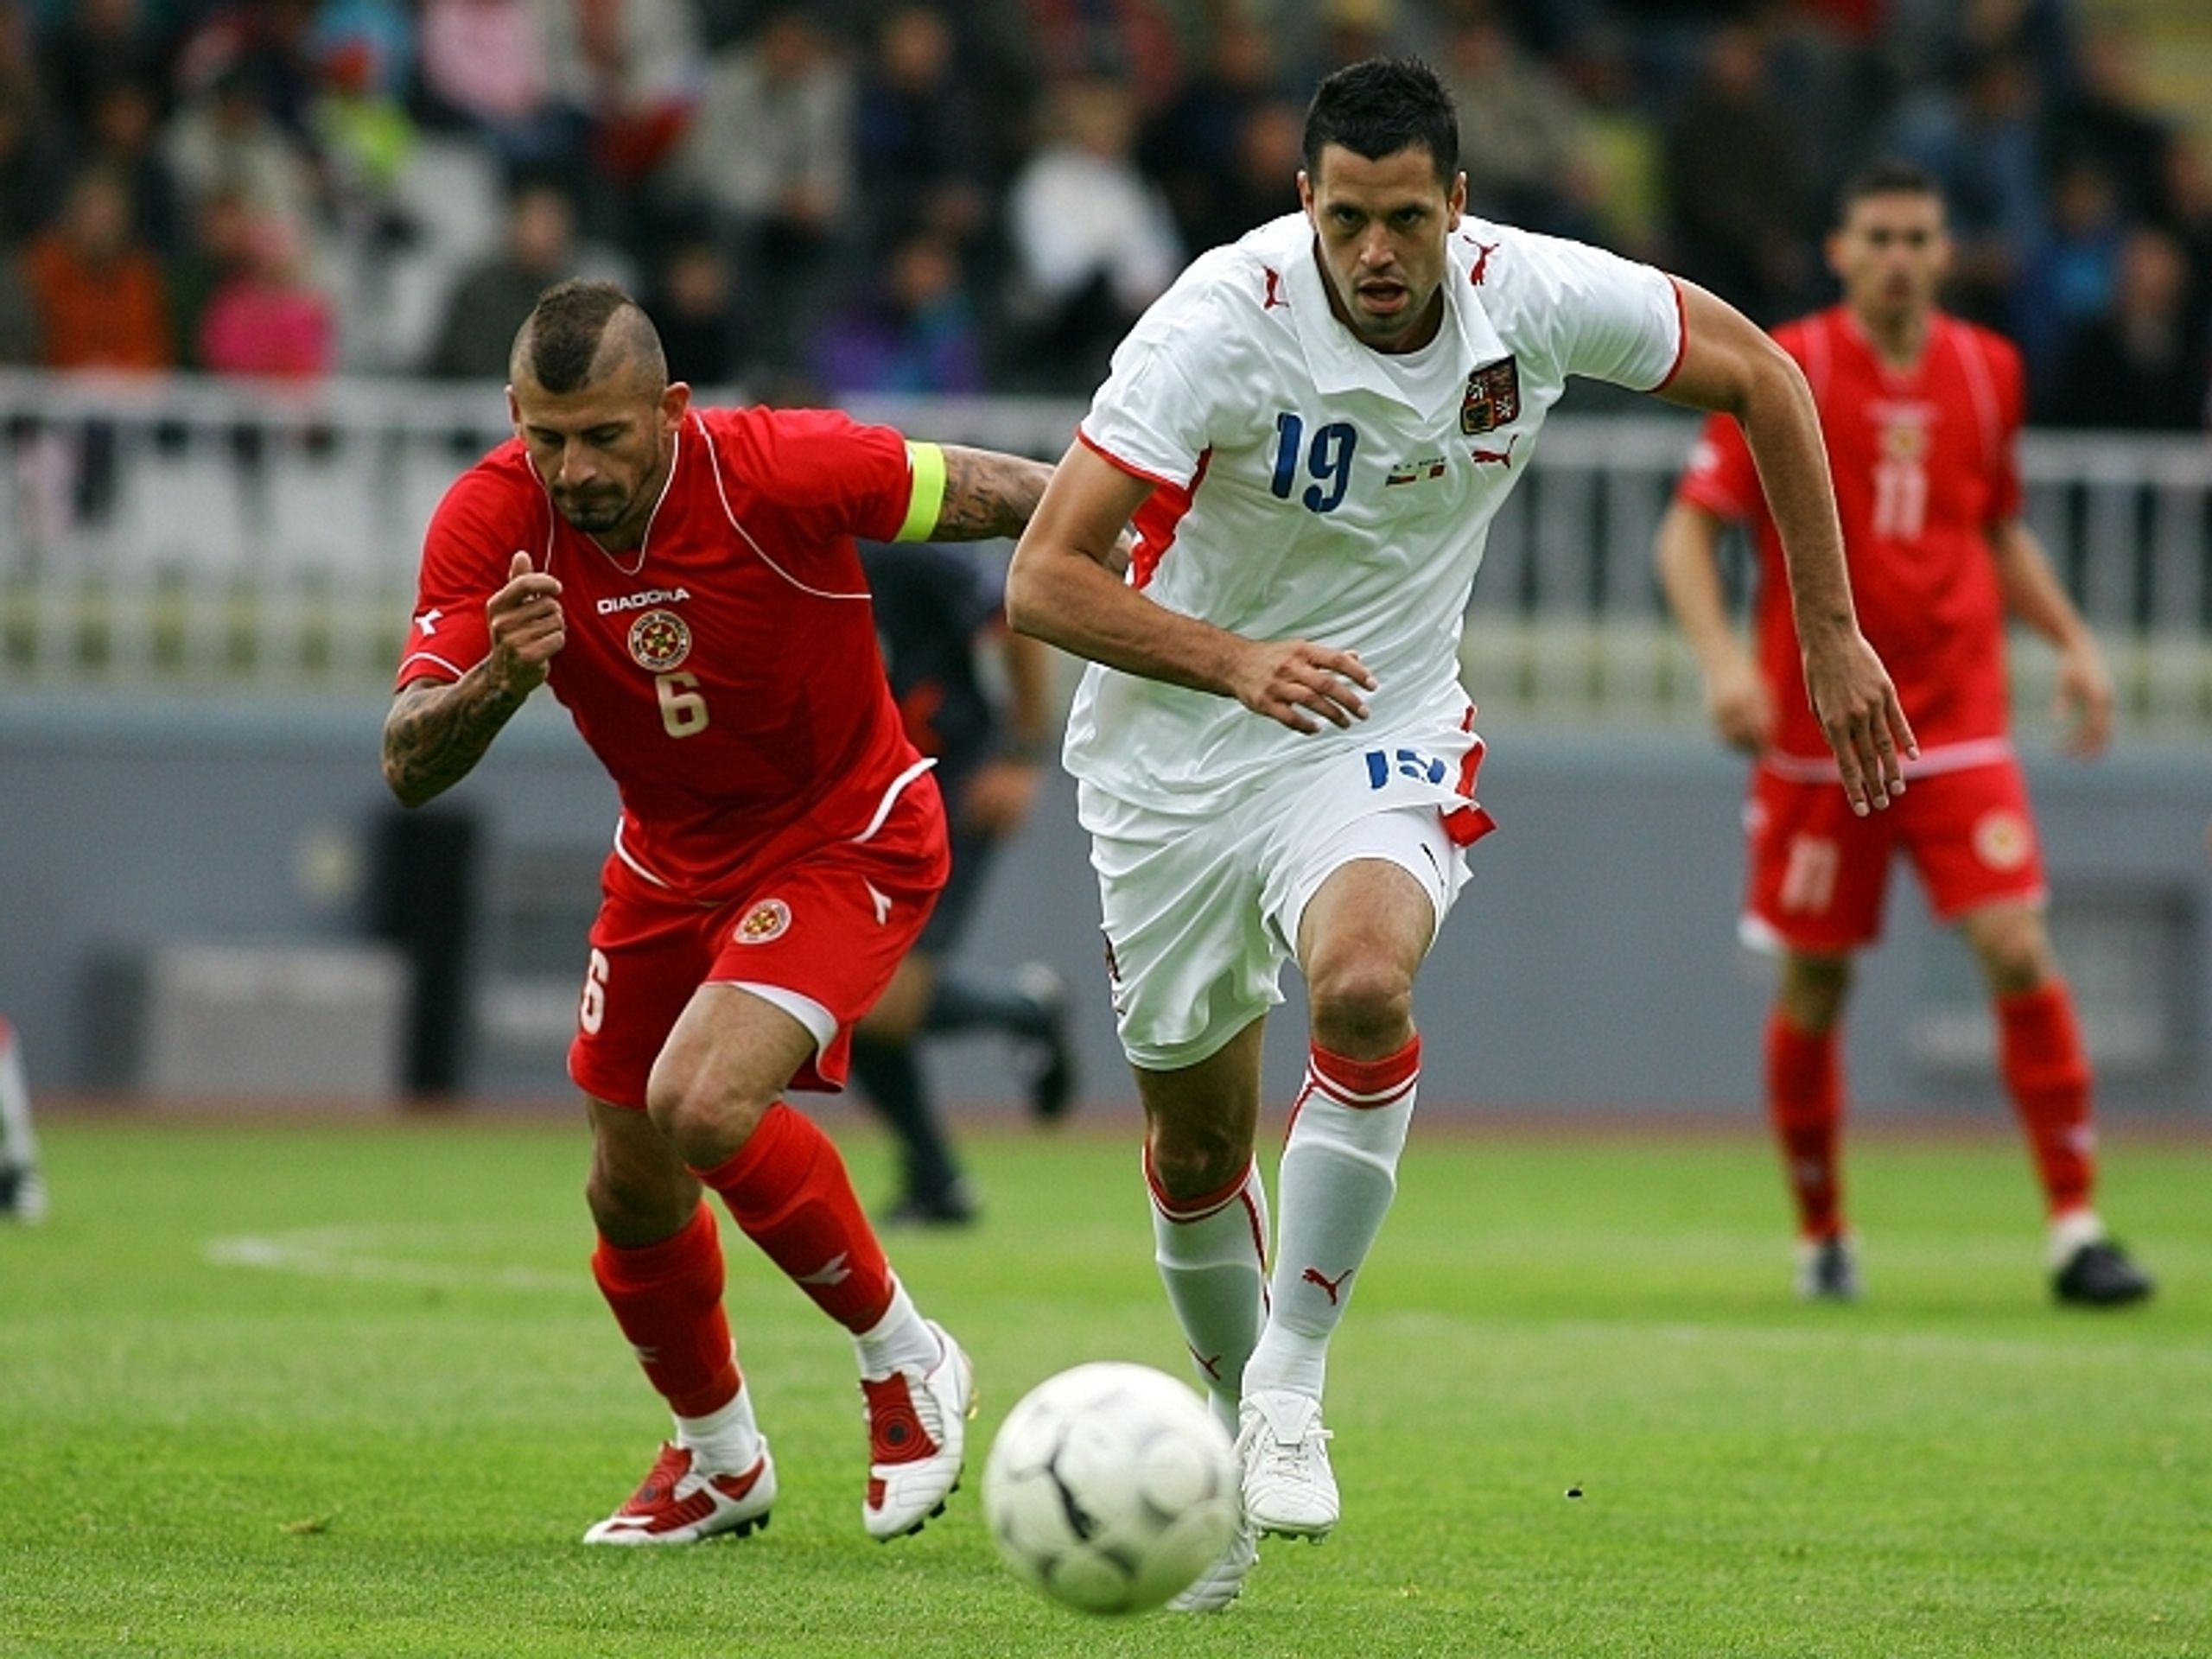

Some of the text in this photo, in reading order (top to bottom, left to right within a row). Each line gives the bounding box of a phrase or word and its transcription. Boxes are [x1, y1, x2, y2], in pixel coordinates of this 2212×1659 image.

[1271, 412, 1357, 512] 19
[655, 671, 709, 739] 6
[580, 948, 609, 1035] 6
